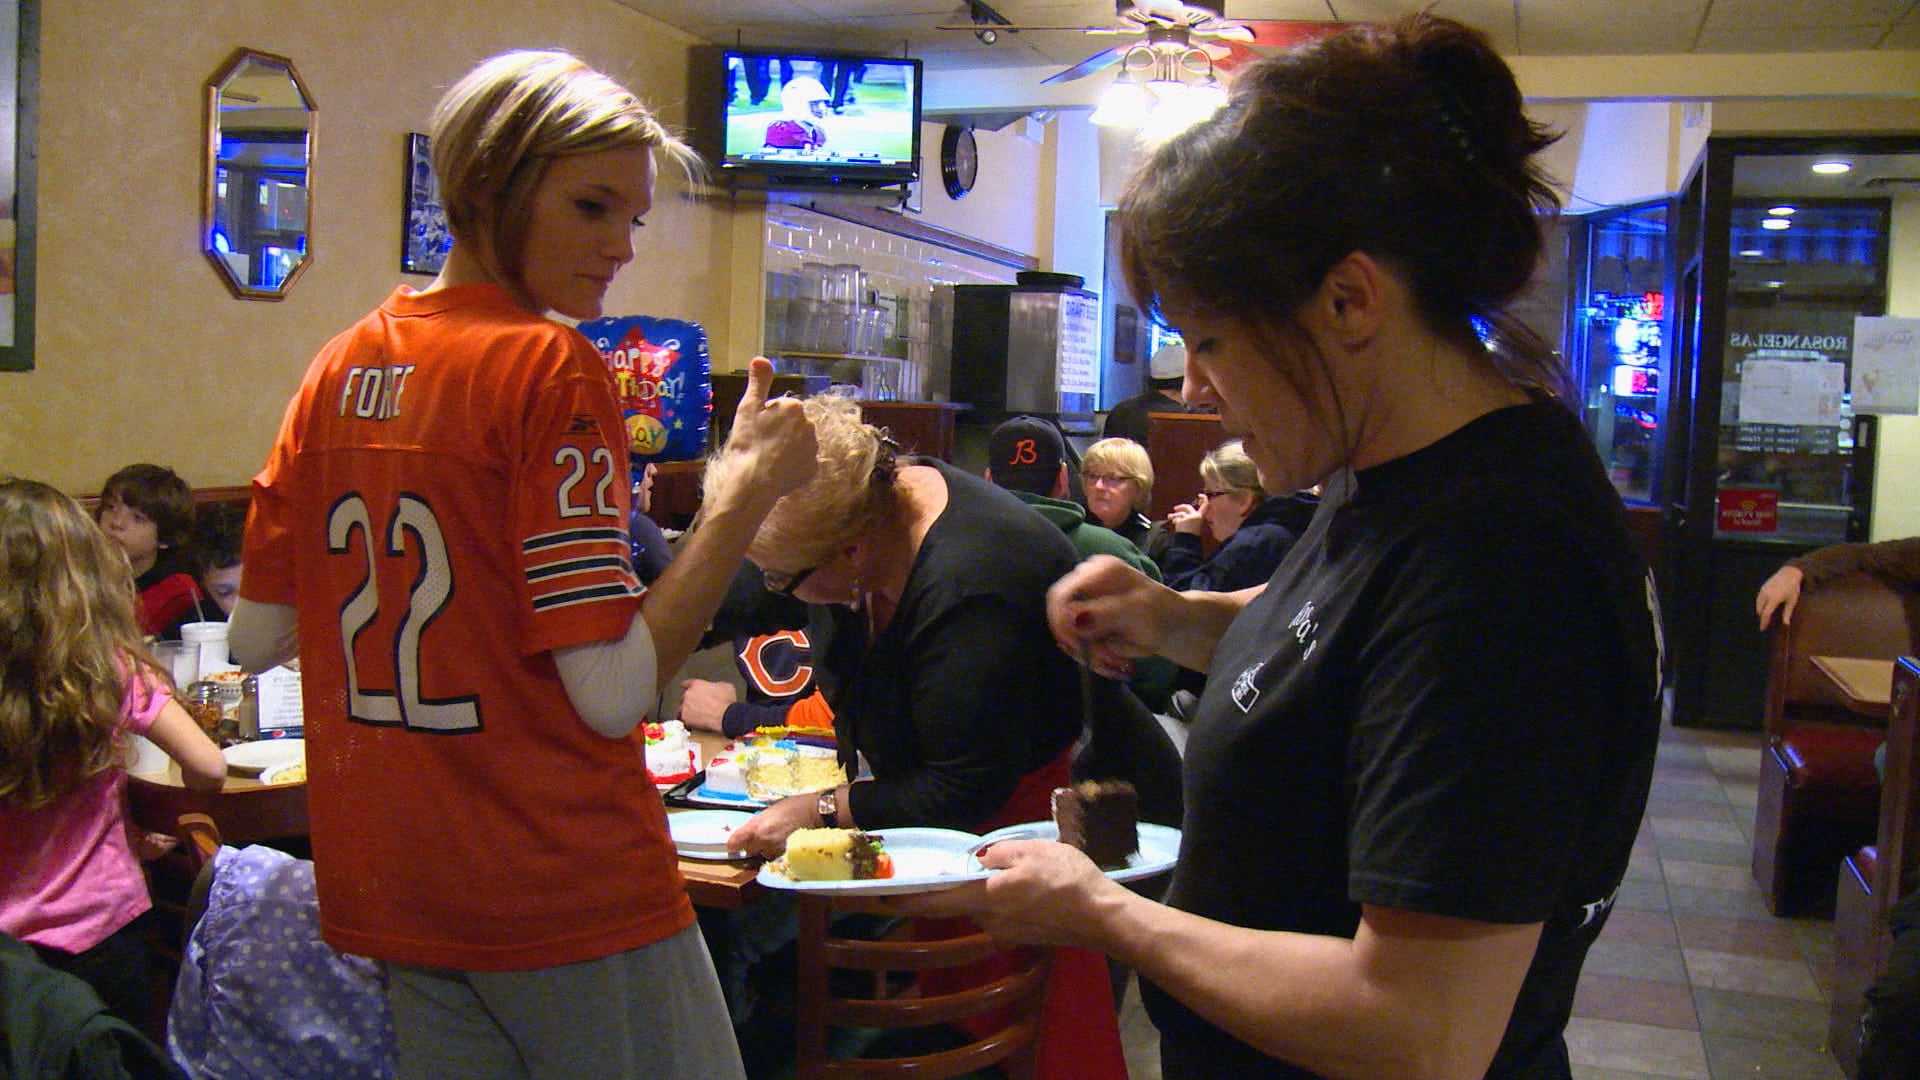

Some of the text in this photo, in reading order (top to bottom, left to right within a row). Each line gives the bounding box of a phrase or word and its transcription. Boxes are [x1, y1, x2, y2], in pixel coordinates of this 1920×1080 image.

[553, 445, 620, 519] 22
[1008, 439, 1038, 465] B
[327, 491, 484, 735] 22
[739, 630, 813, 697] C
